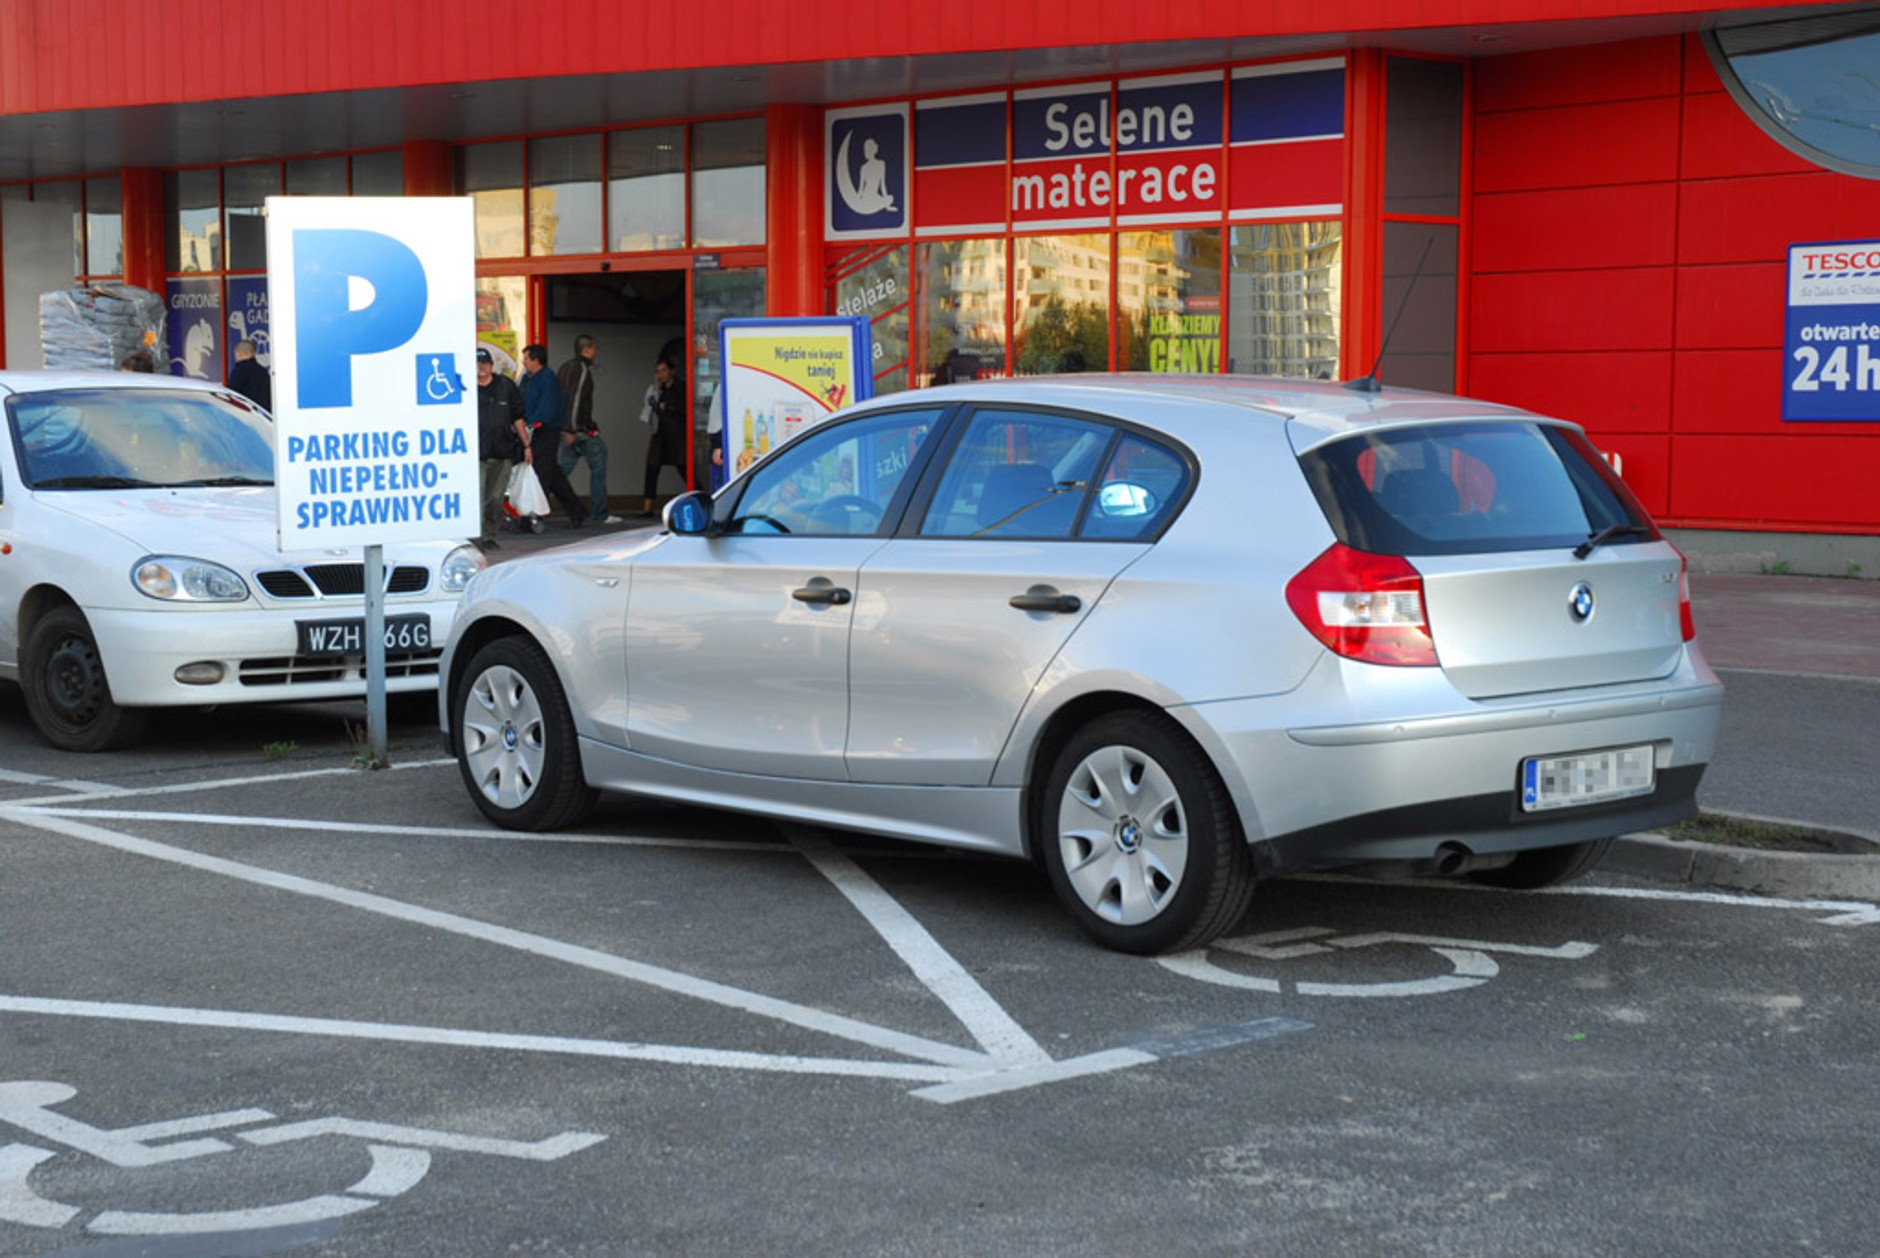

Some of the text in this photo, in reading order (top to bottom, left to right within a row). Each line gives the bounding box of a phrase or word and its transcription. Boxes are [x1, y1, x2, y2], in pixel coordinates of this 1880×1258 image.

[1044, 98, 1195, 151] Selene
[1011, 162, 1216, 211] materace
[1802, 251, 1880, 271] TESCO
[170, 293, 220, 309] GRYZONIE
[292, 228, 428, 409] P
[1801, 322, 1880, 341] otwarte
[775, 346, 806, 363] Nigdzie
[807, 362, 835, 380] taniej
[1149, 337, 1220, 374] CENY!
[288, 428, 467, 463] PARKING DLA
[309, 462, 448, 495] NIEPEŁNO-
[297, 492, 461, 529] SPRAWNYCH
